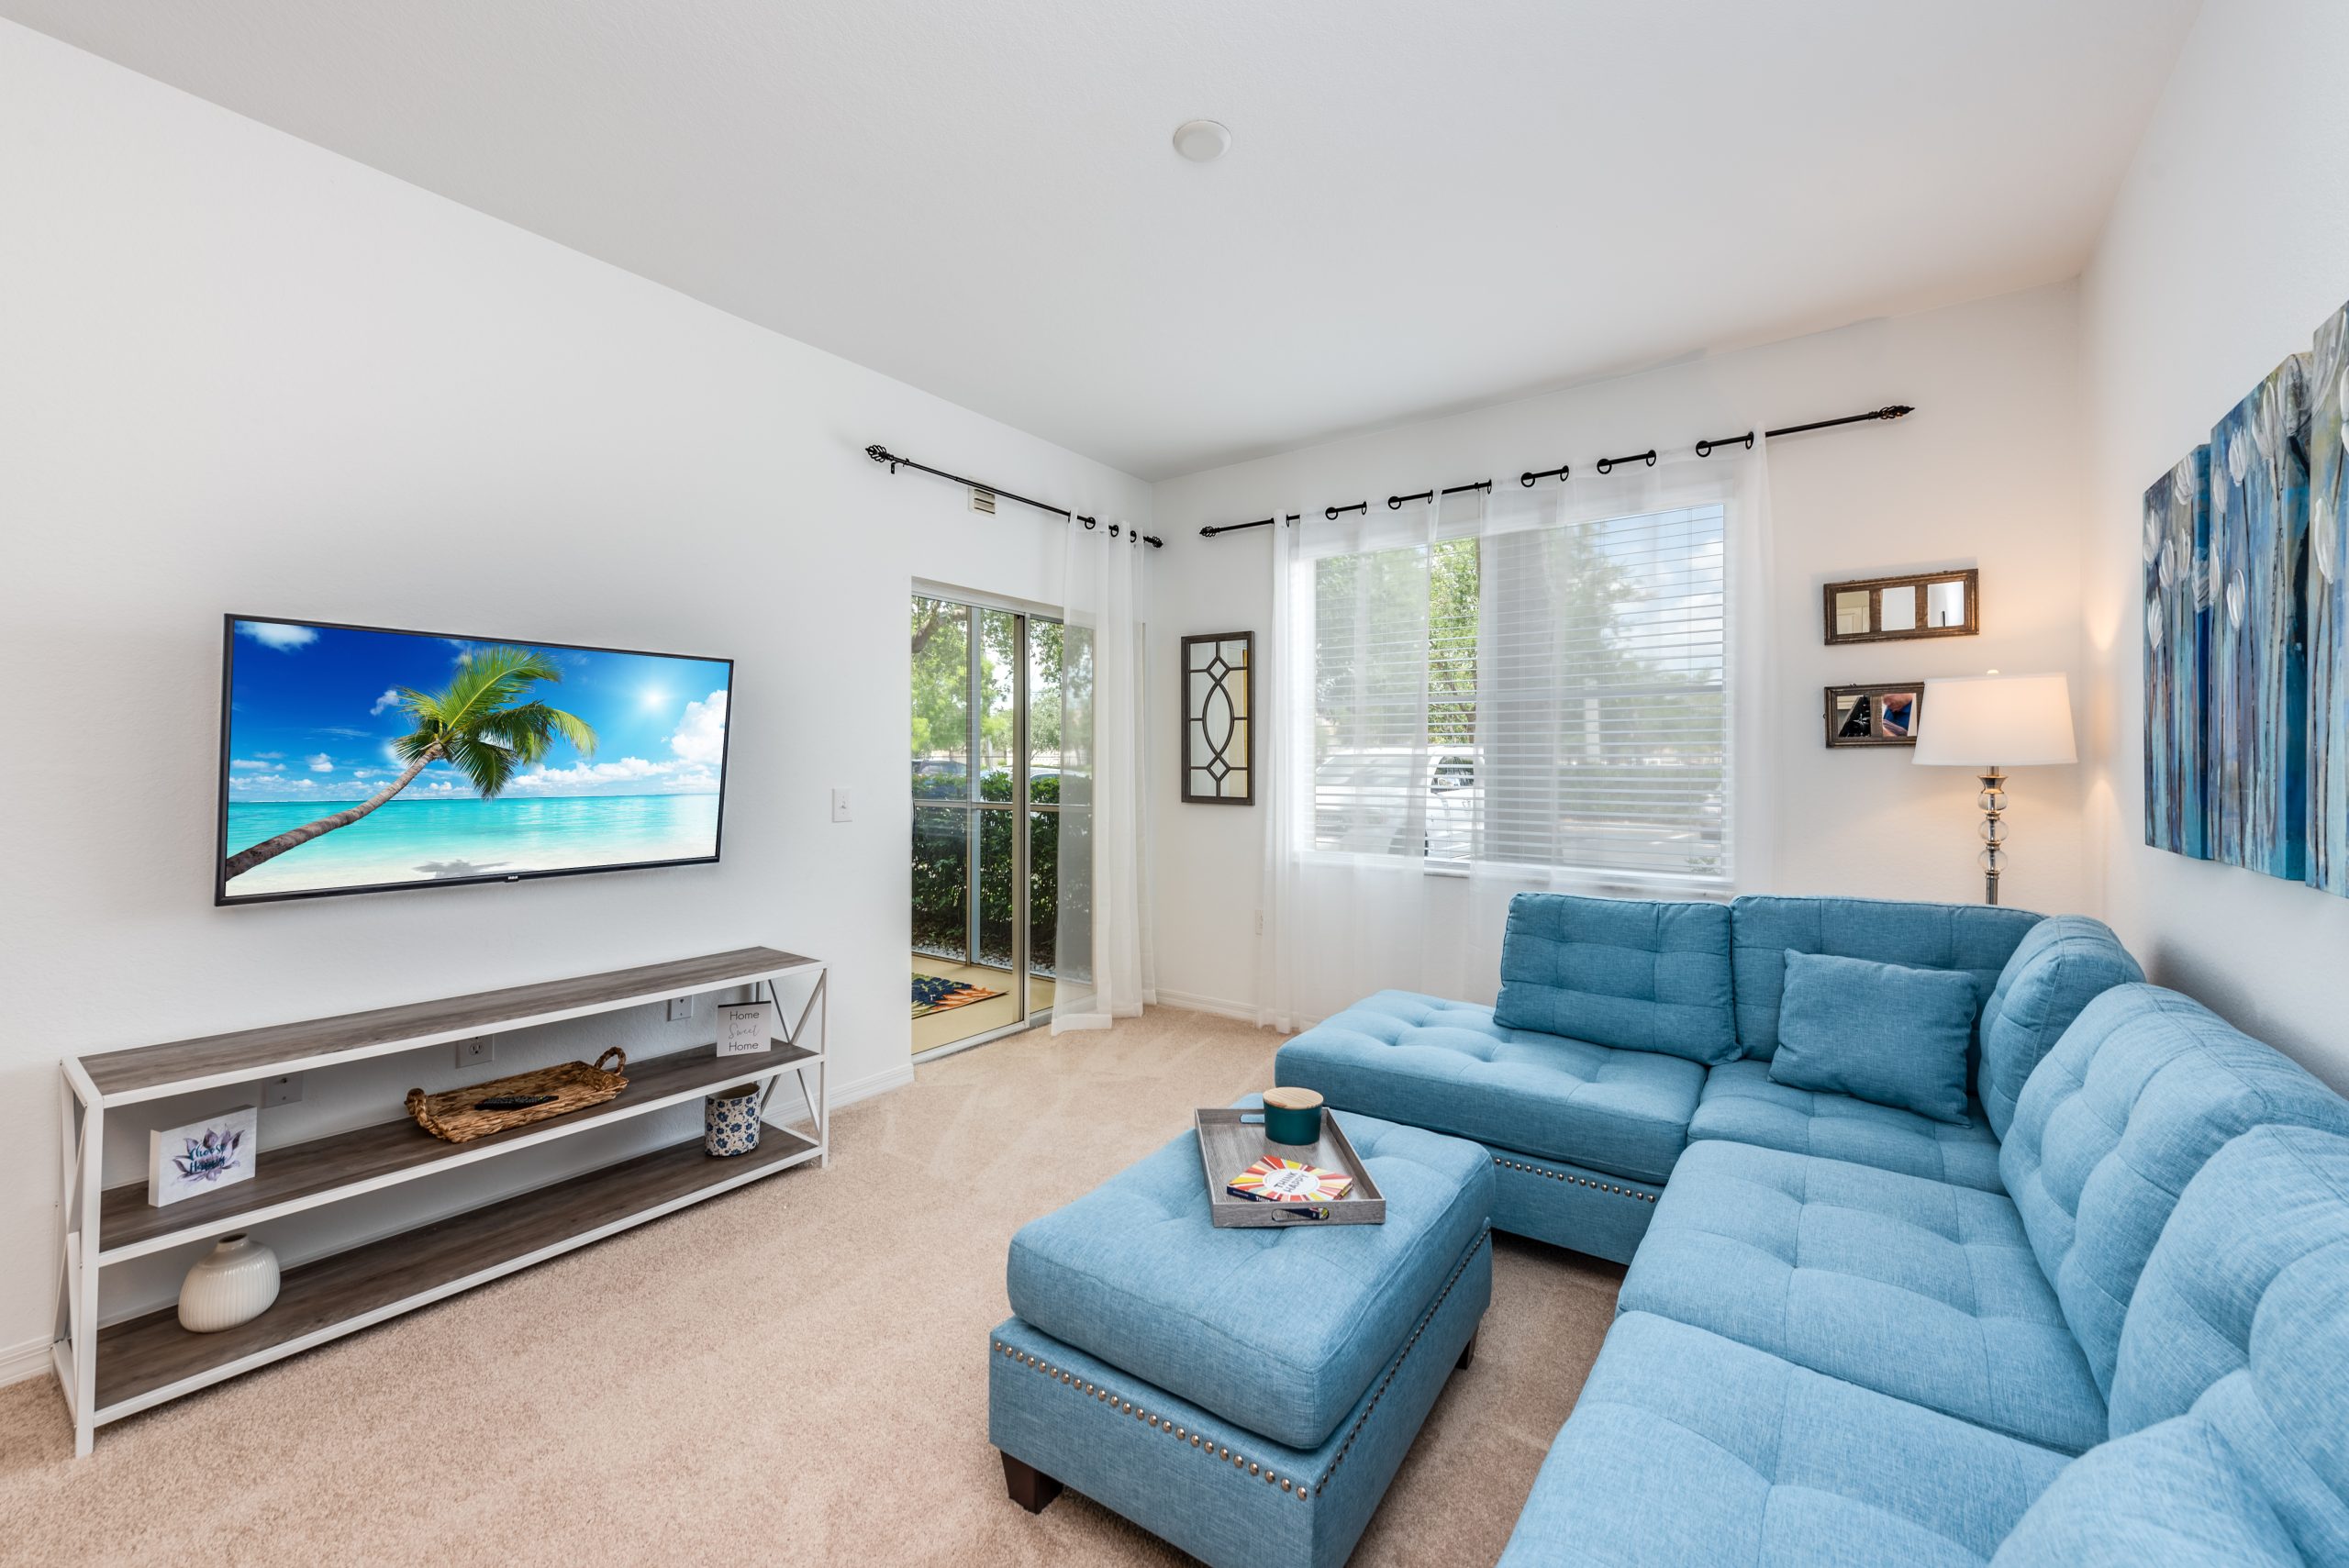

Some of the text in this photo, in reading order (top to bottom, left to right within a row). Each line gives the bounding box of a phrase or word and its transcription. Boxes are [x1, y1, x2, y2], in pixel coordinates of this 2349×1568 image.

[729, 1010, 760, 1020] Home
[729, 1023, 759, 1039] Sweet
[729, 1042, 759, 1051] Home
[1274, 1171, 1298, 1188] THINK
[1283, 1173, 1308, 1193] HAPPY
